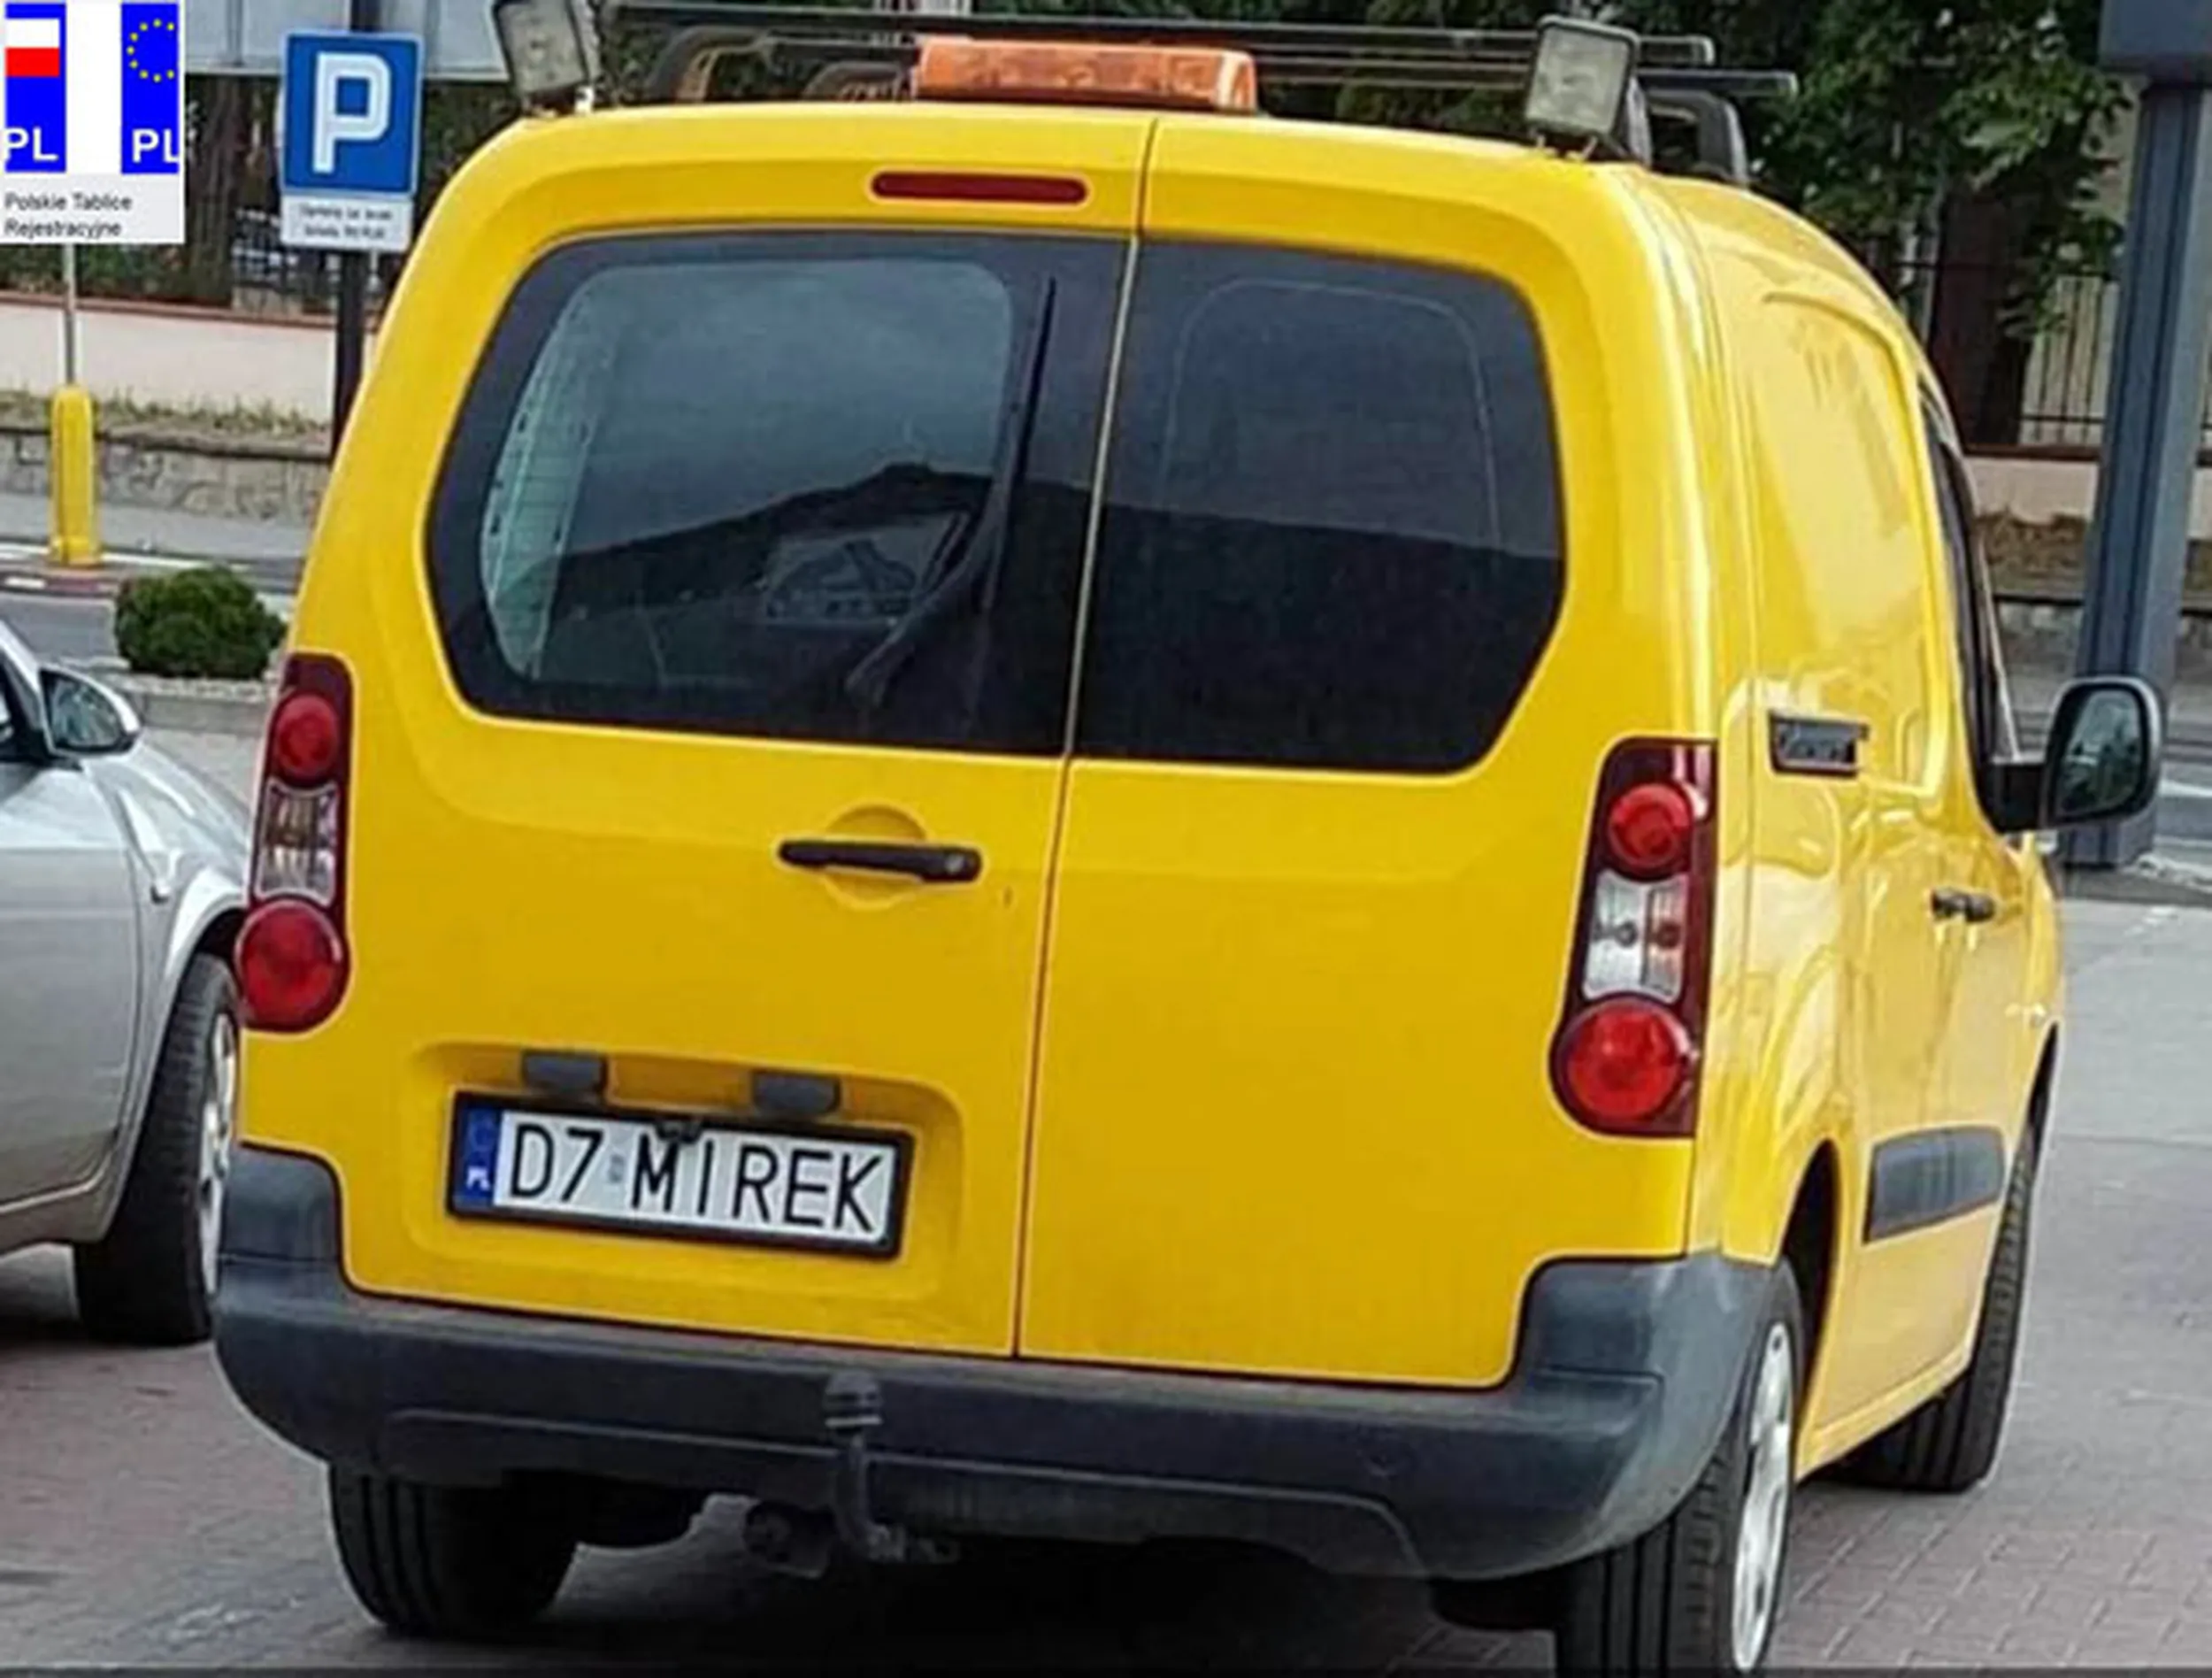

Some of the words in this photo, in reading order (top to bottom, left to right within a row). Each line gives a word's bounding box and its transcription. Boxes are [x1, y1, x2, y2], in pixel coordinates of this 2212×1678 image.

[312, 51, 391, 173] P
[509, 1122, 604, 1203] D7
[631, 1133, 882, 1233] MIREK
